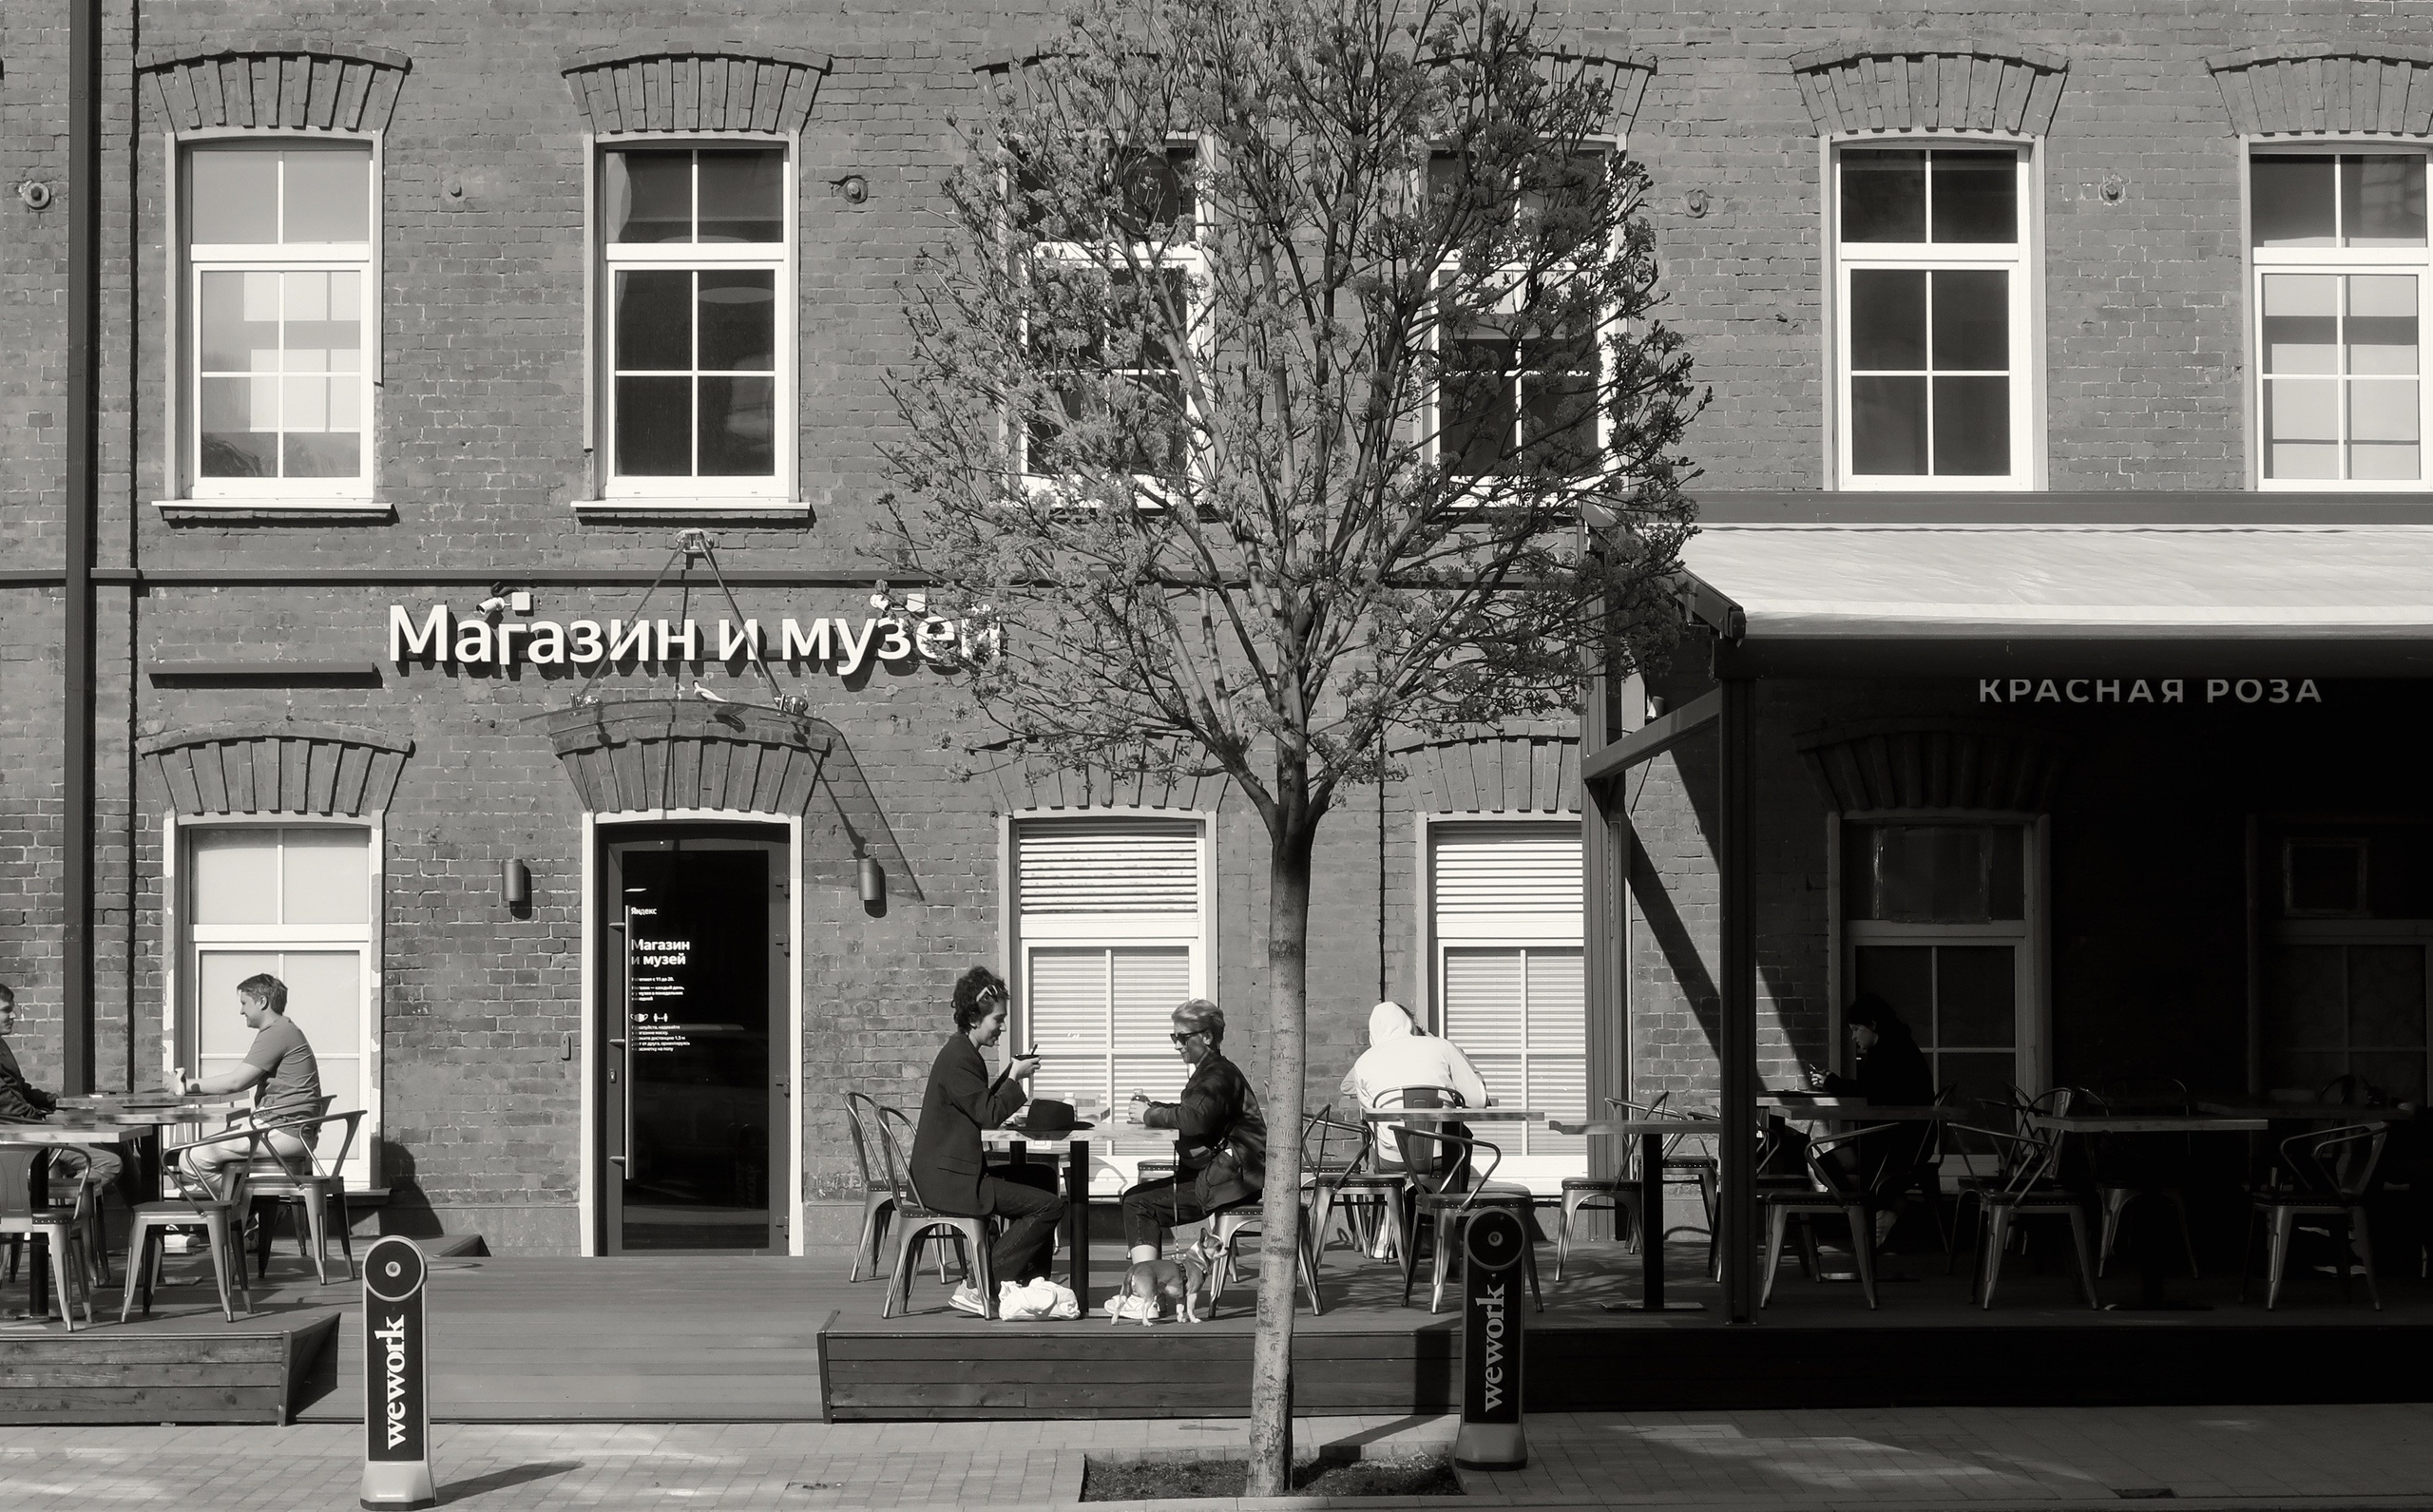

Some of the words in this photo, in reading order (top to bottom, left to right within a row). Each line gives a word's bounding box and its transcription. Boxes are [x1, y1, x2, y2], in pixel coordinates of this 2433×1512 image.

[388, 603, 696, 666] Магазин
[718, 619, 757, 661] и
[1979, 679, 2184, 703] КРАСНАЯ
[2206, 679, 2323, 703] РОЗА
[630, 906, 658, 916] Яндекс
[631, 938, 691, 951] Магазин
[631, 955, 641, 966] и
[642, 952, 686, 968] музей
[1474, 1283, 1505, 1413] wework
[374, 1313, 407, 1450] wework
